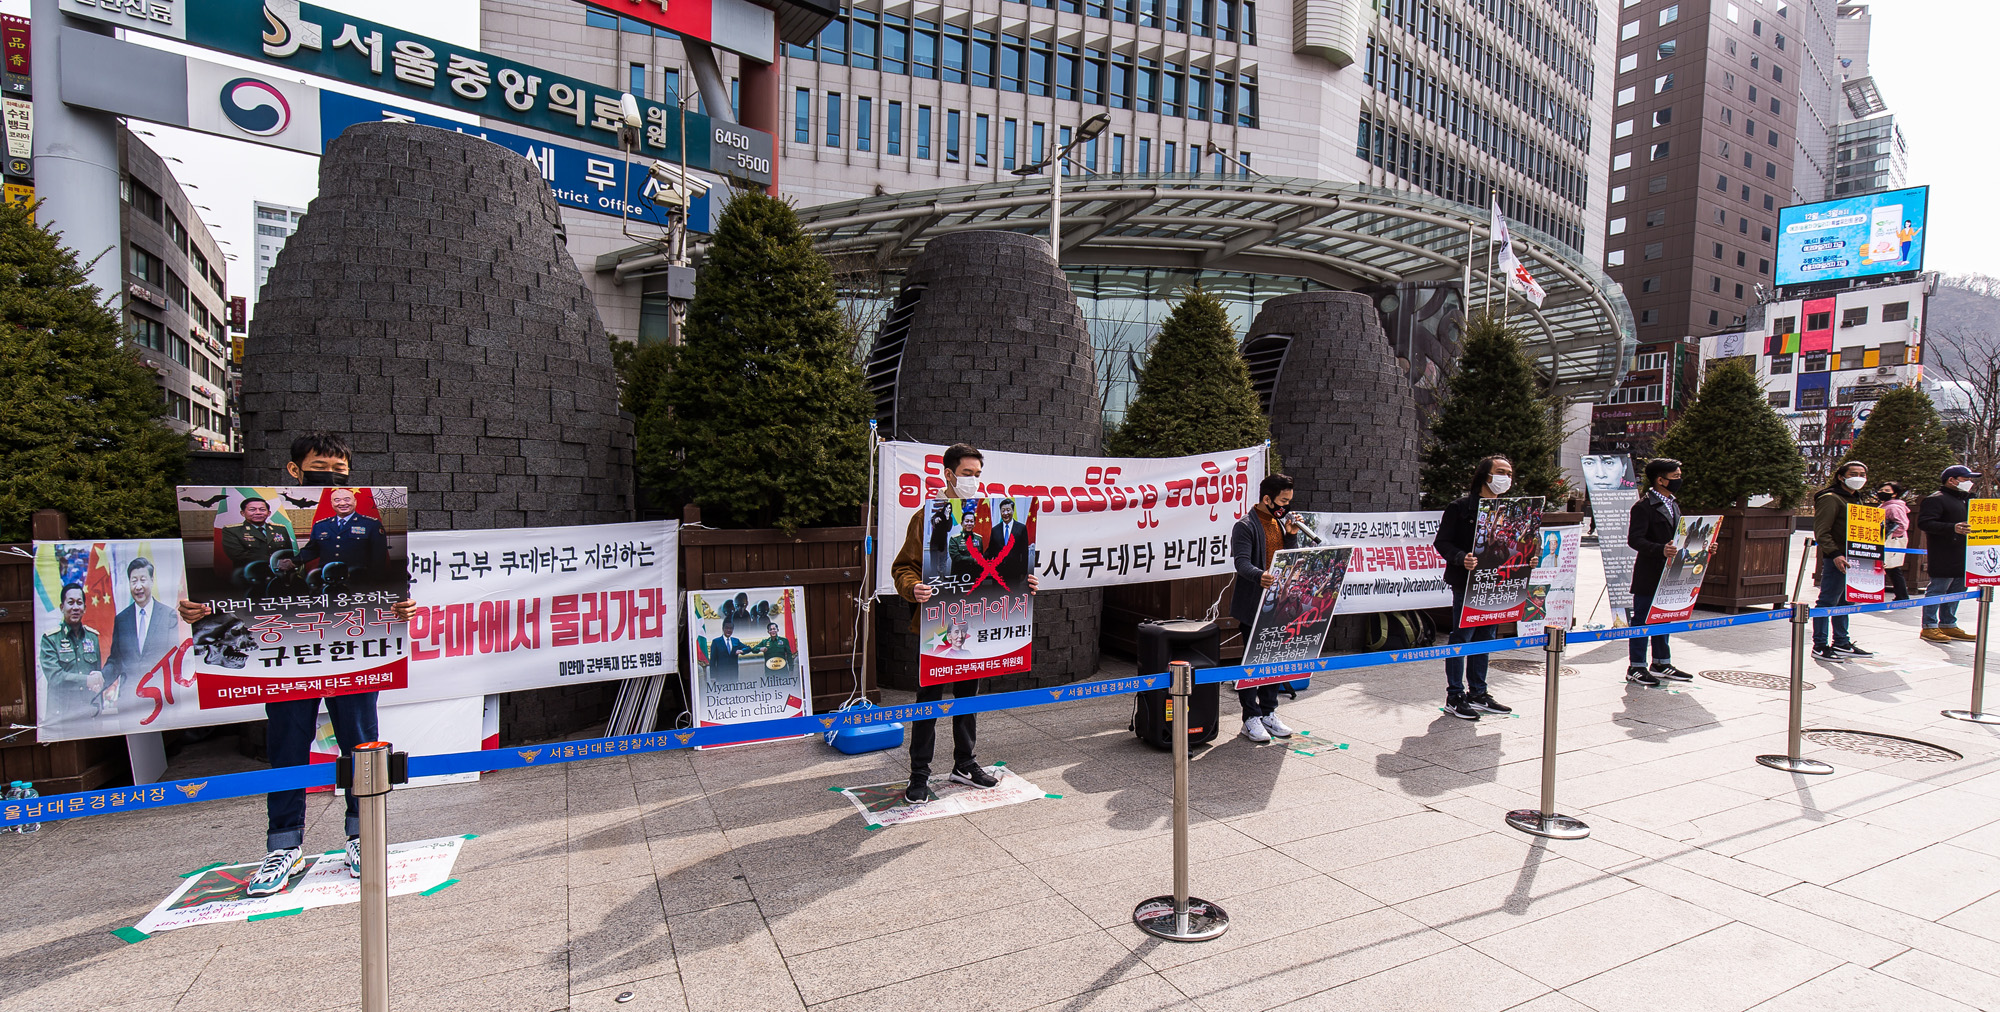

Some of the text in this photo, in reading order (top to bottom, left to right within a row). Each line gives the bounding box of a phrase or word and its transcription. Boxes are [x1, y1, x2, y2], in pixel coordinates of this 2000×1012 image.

[75, 0, 173, 25] 반진료
[7, 27, 27, 68] 一品香
[13, 83, 25, 91] 2F
[332, 22, 626, 134] 서울중앙의료
[7, 109, 29, 121] 수집
[8, 119, 30, 131] 뱅크
[9, 132, 30, 140] 코리아
[646, 105, 667, 149] 의원
[715, 128, 750, 150] 6450
[13, 162, 27, 171] 3F
[598, 195, 643, 216] Office
[1620, 477, 1635, 488] Free
[1332, 521, 1350, 539] 대국
[1350, 522, 1368, 539] 같은
[1369, 521, 1401, 539] 소리하고
[1401, 521, 1417, 538] 있네
[448, 551, 493, 581] 군부
[499, 546, 578, 577] 쿠데타군
[584, 540, 656, 571] 지원하는
[1035, 534, 1234, 581] 사 쿠데타 반대한
[1366, 546, 1406, 572] 군부독재
[927, 573, 975, 597] 중국은
[1474, 567, 1499, 582] 중국은
[1340, 575, 1447, 600] yanmar Military Dictatorship
[1473, 577, 1529, 595] 미얀마 군부독재
[204, 590, 400, 614] 미얀마 군부독재 옹호하는
[1470, 591, 1519, 608] 지원 중단하라
[550, 587, 667, 648] 물러가라
[926, 593, 1029, 628] 미얀마에서
[248, 607, 406, 644] 중국정부
[977, 624, 1031, 643] 물러가라!
[1259, 624, 1287, 641] 중국은
[258, 636, 403, 668] 규탄한다!
[1256, 633, 1322, 654] 미얀마 군부독재
[559, 652, 663, 677] 미얀마 군부독재 타도 위원회
[1251, 646, 1308, 664] 지원 중단하라
[929, 656, 1024, 679] 미얀마 군부독재 타도 위원회
[1258, 661, 1315, 675] 서울남대문경찰서장
[217, 685, 264, 699] 미얀마
[265, 679, 322, 698] 군부독재
[325, 678, 352, 690] 타도
[354, 672, 394, 687] 위원회
[706, 675, 799, 696] Myanmar Military
[1068, 678, 1140, 698] 서울남대문경찰서장
[706, 690, 783, 708] Dictatorship is
[707, 704, 784, 721] Made in china
[842, 705, 933, 726] 서울남대문경찰서장
[549, 735, 668, 759] 서울남대문경찰서장
